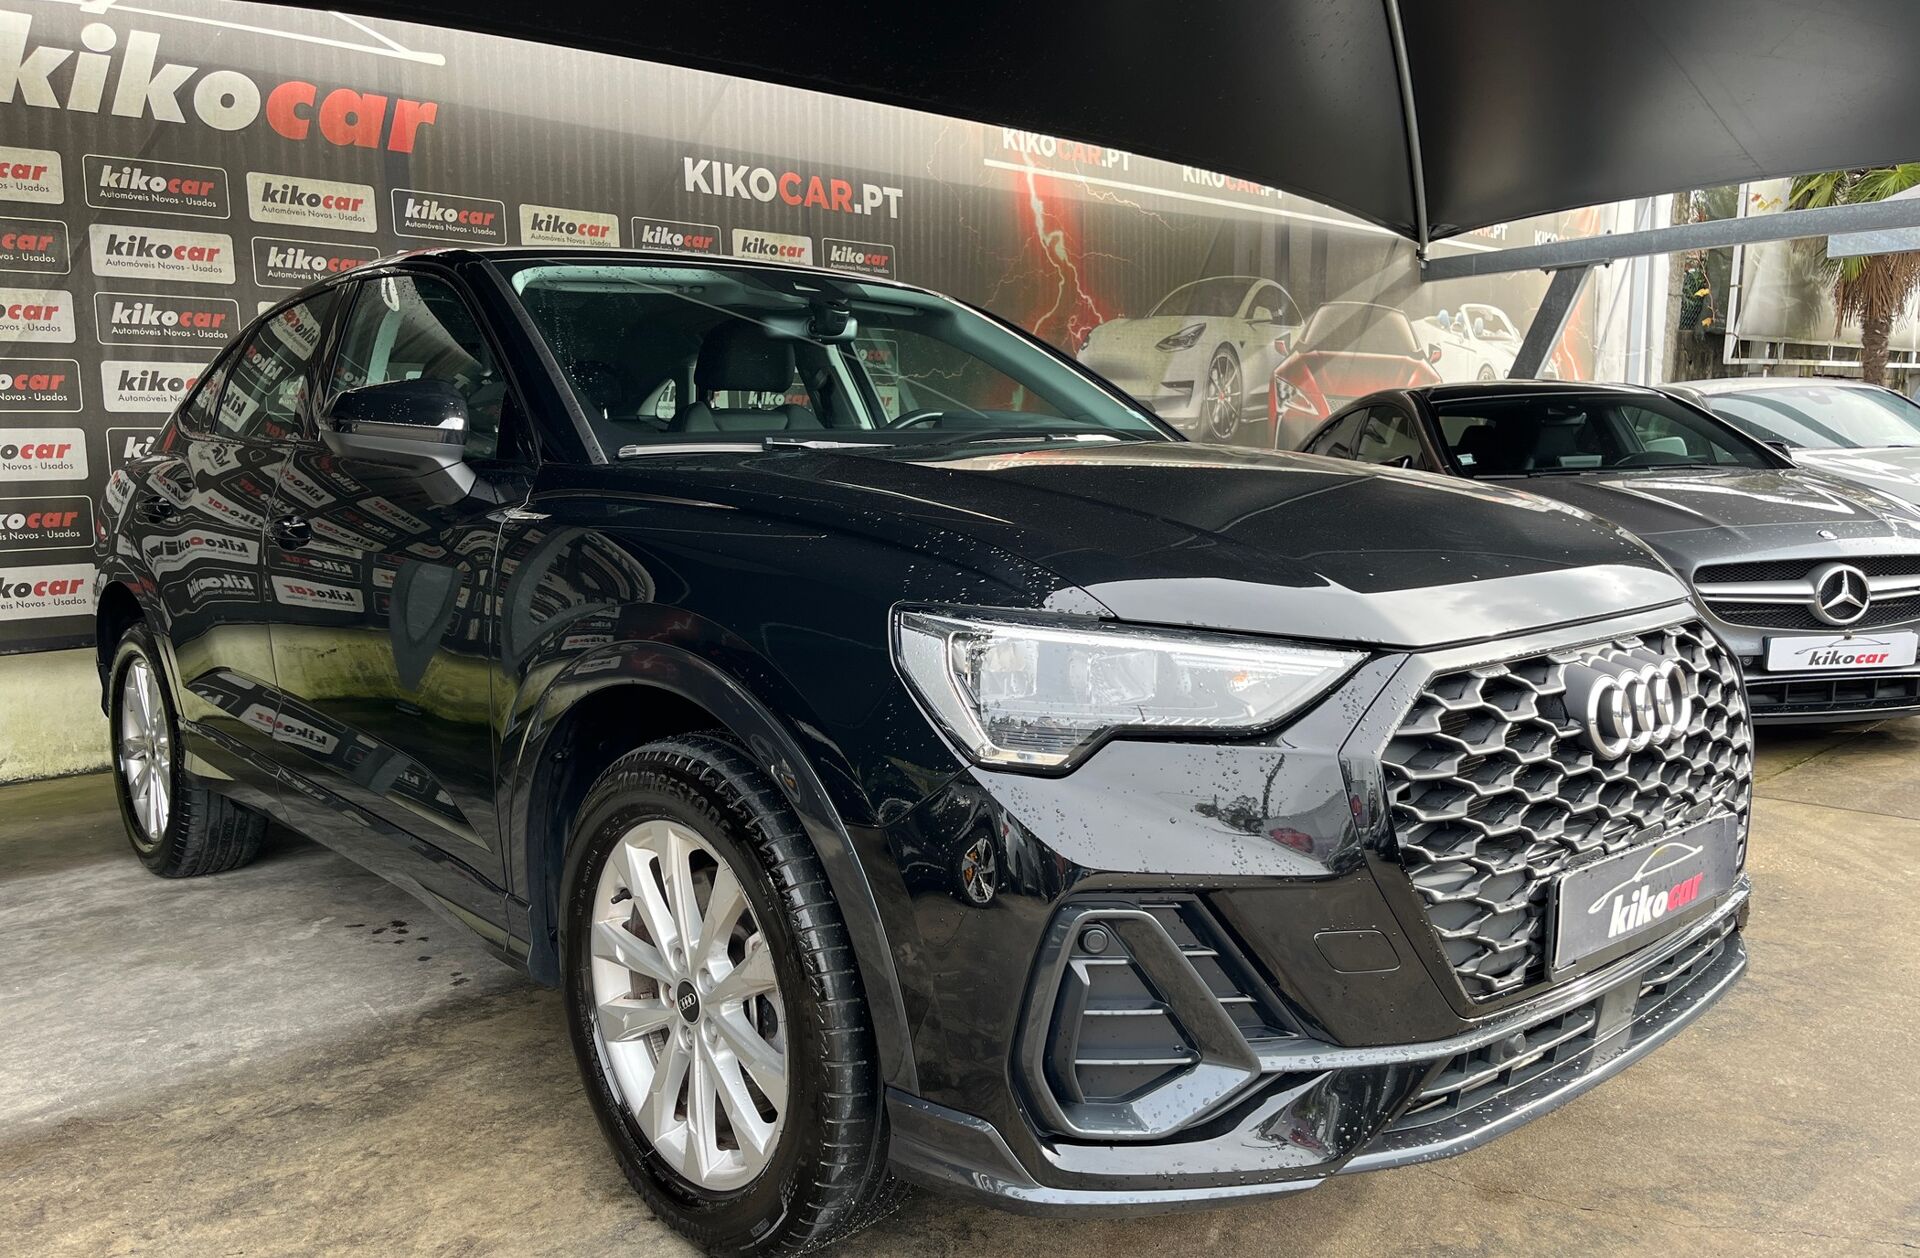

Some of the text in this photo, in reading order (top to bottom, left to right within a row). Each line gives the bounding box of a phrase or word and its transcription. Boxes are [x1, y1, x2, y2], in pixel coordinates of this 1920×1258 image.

[0, 9, 438, 154] kikocar
[1001, 127, 1132, 171] KIKOCAR.PT
[16, 182, 50, 193] Usados
[100, 164, 215, 196] kikocar
[683, 156, 903, 219] KIKOCAR.PT
[100, 189, 149, 202] Automóveis
[151, 193, 179, 205] Novos
[186, 197, 217, 208] Usados
[261, 182, 364, 212] kikocar
[261, 205, 307, 217] Automóveis
[308, 209, 333, 220] Novos
[338, 212, 366, 223] Usados
[404, 198, 496, 226] kikocar
[405, 219, 444, 231] Automóveis
[445, 224, 468, 234] Novos
[472, 226, 497, 236] Usados
[530, 212, 610, 239] kikocar
[641, 225, 714, 250] kikocar
[106, 234, 220, 262] kikocar
[741, 236, 805, 258] kikocar
[830, 245, 888, 267] kikocar
[22, 252, 56, 263] Usados
[105, 259, 155, 269] Automóveis
[157, 262, 185, 271] Novos
[192, 264, 223, 274] Usados
[267, 269, 312, 280] Automóveis
[111, 301, 226, 328] kikocar
[27, 323, 62, 333] Usados
[111, 326, 161, 336] Automóveis
[163, 328, 191, 338] Novos
[197, 329, 228, 339] Usados
[34, 391, 68, 401] Usados
[118, 394, 167, 402] Automóveis
[3, 462, 33, 470] Novos
[40, 461, 74, 470] Usados
[9, 532, 39, 540] Novos
[47, 530, 81, 538] Usados
[16, 600, 46, 609] Novos
[53, 597, 87, 606] Usados
[1808, 651, 1889, 666] kikocar
[1608, 872, 1704, 939] kikocar
